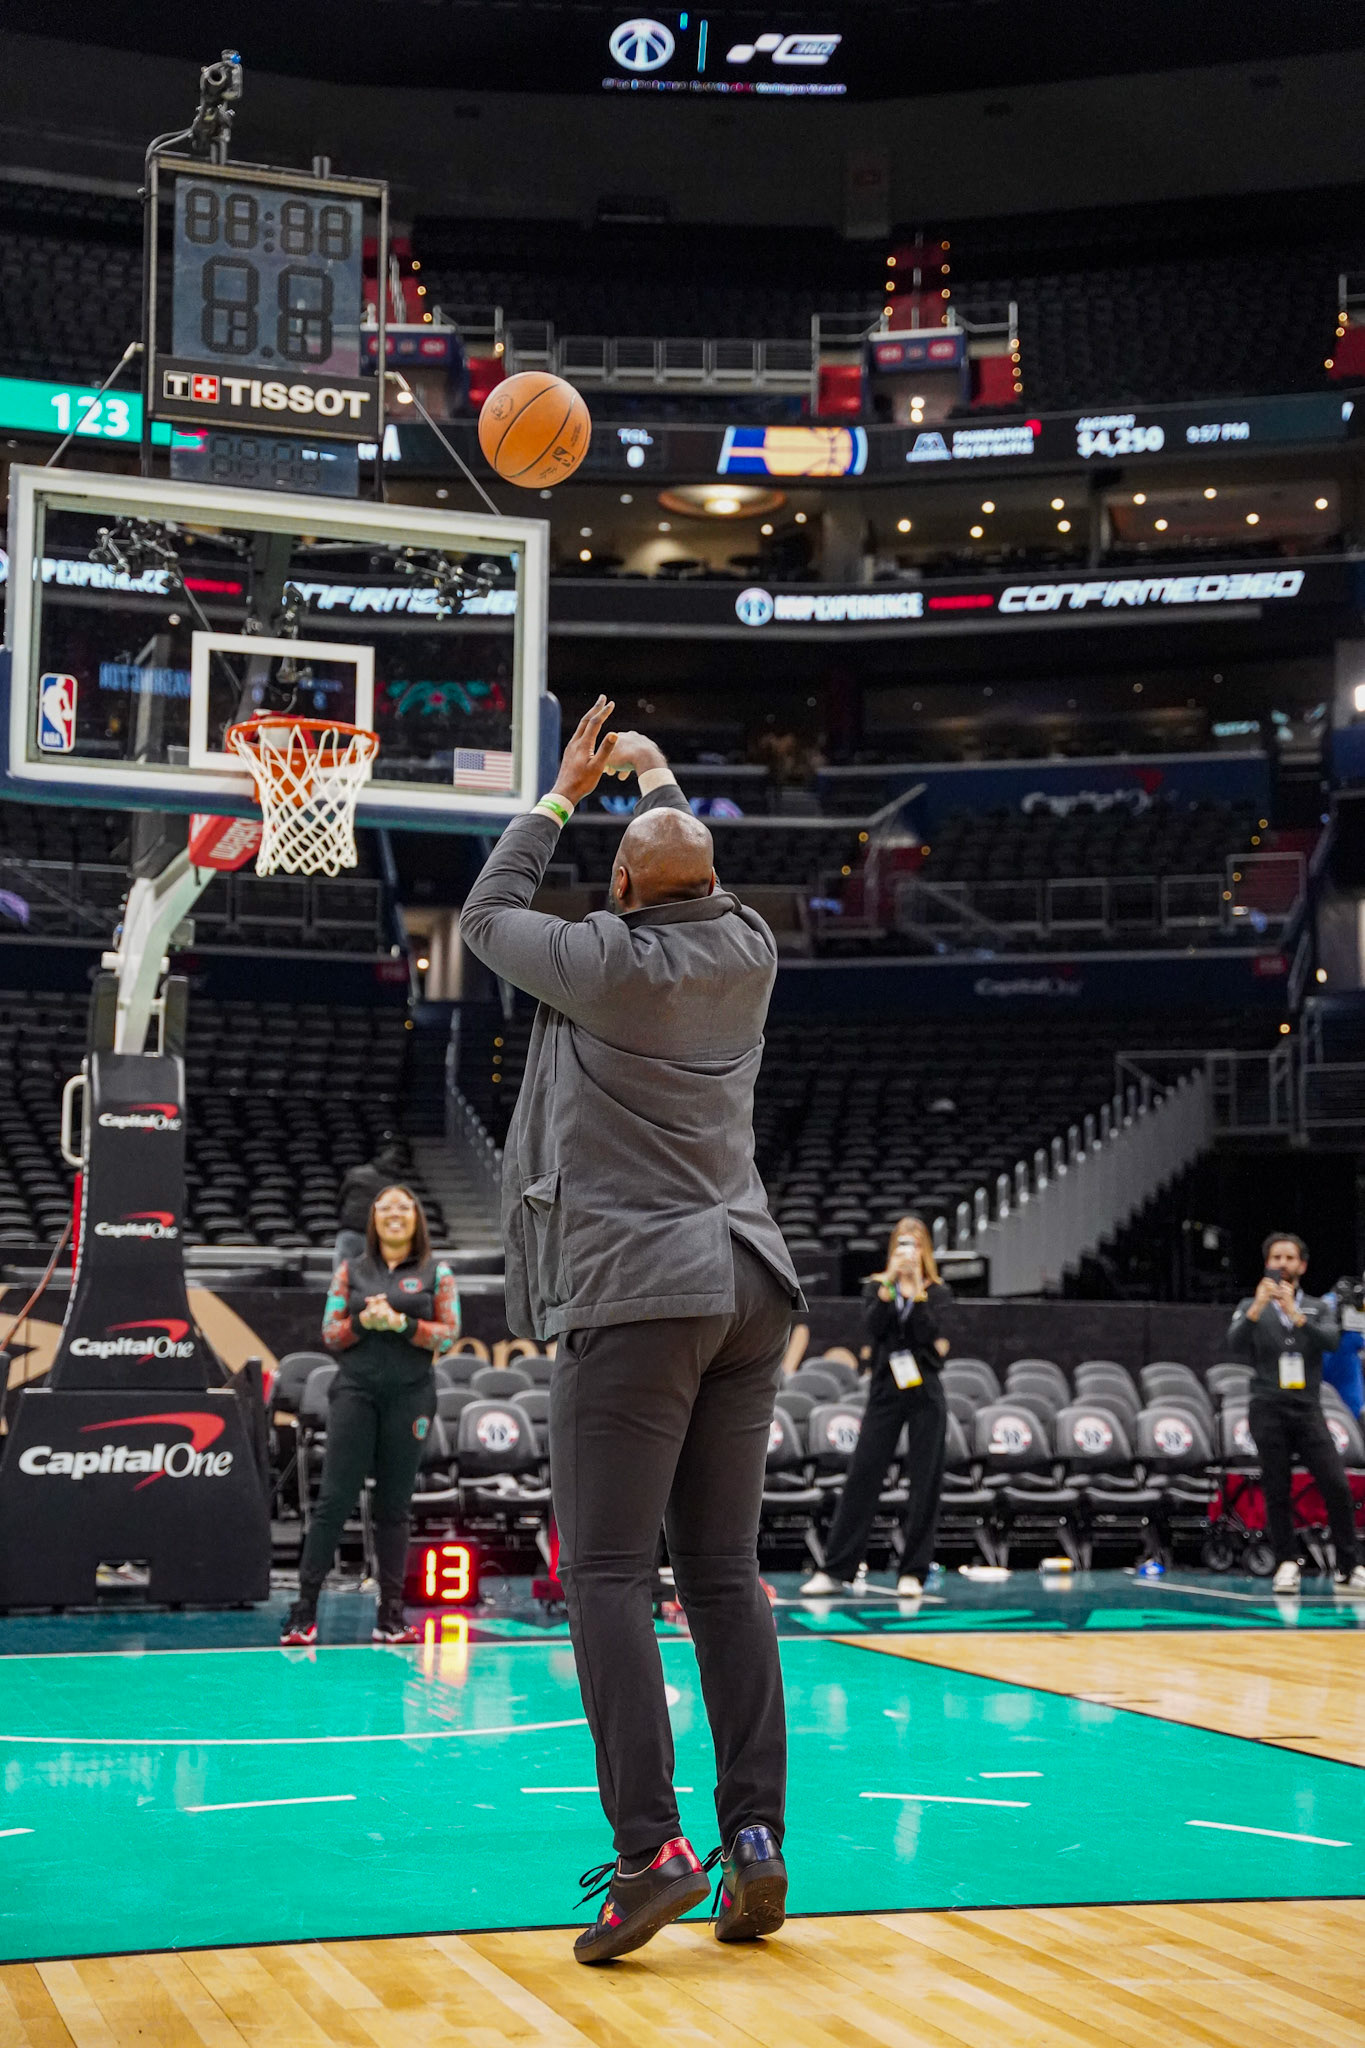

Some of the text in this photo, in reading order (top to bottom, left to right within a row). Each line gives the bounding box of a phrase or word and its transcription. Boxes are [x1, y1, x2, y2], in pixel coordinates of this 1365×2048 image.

[50, 392, 130, 437] 123
[221, 376, 371, 419] TISSOT
[998, 570, 1305, 613] CONFIRMED360
[425, 1545, 470, 1600] 13
